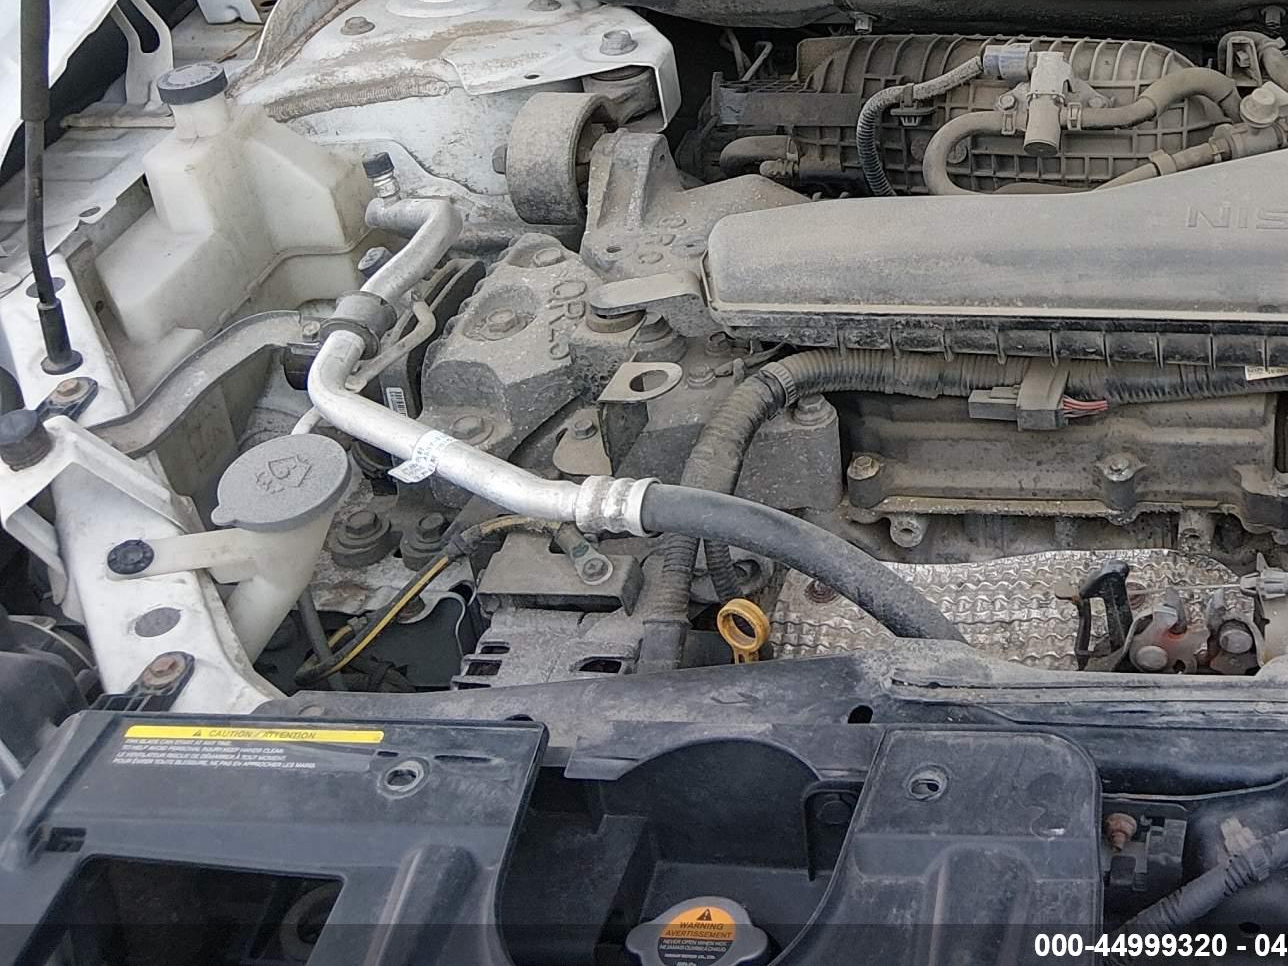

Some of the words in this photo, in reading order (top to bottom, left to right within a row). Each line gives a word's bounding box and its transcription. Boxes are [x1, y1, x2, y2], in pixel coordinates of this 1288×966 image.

[208, 729, 254, 738] CAUTION
[262, 730, 317, 739] ATTENTION
[680, 921, 724, 930] WARNING
[664, 929, 732, 939] AVERTISSEMENT
